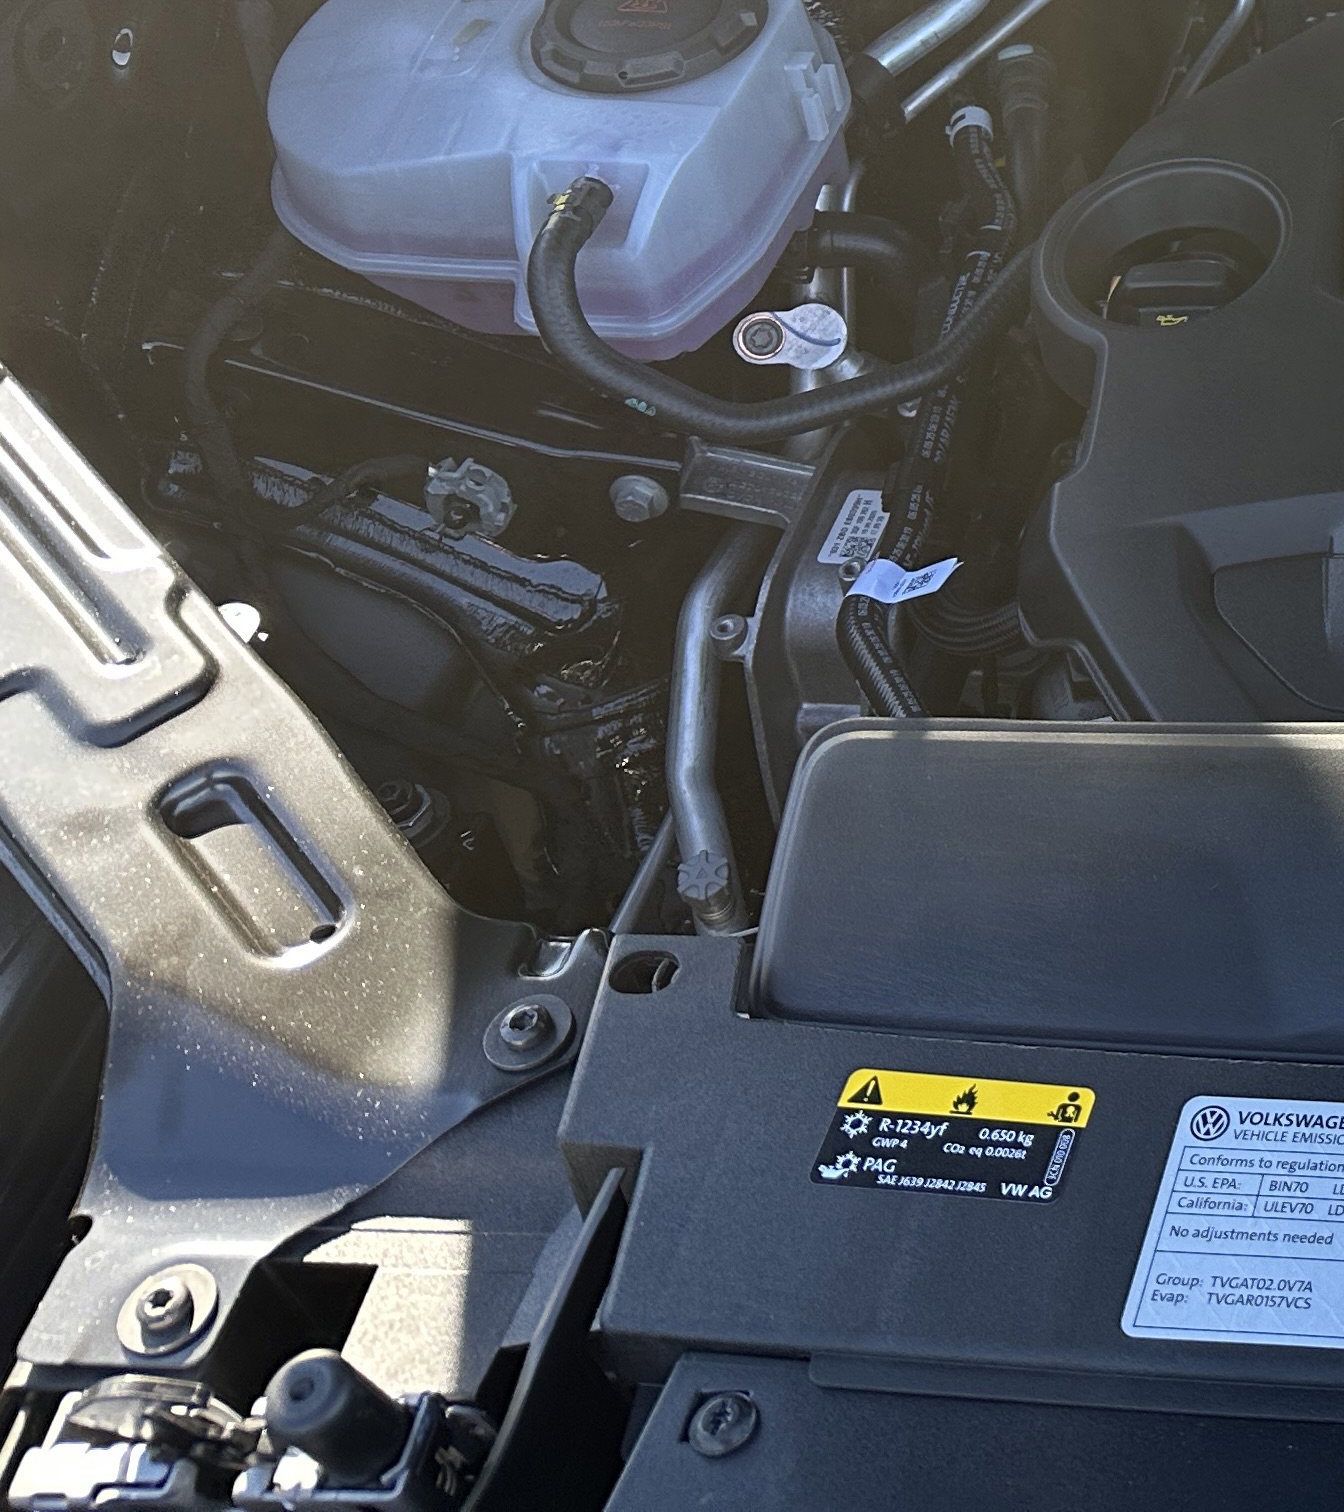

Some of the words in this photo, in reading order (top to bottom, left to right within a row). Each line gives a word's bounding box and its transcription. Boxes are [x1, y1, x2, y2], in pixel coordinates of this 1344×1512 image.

[879, 1118, 949, 1139] R-1234yf
[872, 1137, 899, 1148] GWP
[900, 1139, 908, 1149] 4
[980, 1128, 1014, 1142] 0.650
[1017, 1129, 1034, 1146] kg
[1234, 1129, 1287, 1143] VEHICLE
[969, 1147, 982, 1158] eq
[986, 1146, 1026, 1160] 0.0026t
[863, 1157, 897, 1173] PAG
[1190, 1154, 1255, 1168] Conforms
[1259, 1157, 1272, 1169] to
[877, 1174, 897, 1186] SAE
[899, 1176, 924, 1188] J639
[1184, 1177, 1208, 1188] U.S.
[1269, 1180, 1309, 1193] BIN70
[1001, 1183, 1026, 1197] VW
[1029, 1185, 1053, 1199] AG
[1178, 1197, 1248, 1211] California:
[1264, 1202, 1314, 1215] ULEV70
[1170, 1225, 1189, 1238] No
[1191, 1226, 1279, 1245] adjustments
[1283, 1230, 1333, 1245] needed
[1156, 1274, 1205, 1291] Group:
[1151, 1290, 1189, 1307] Evap:
